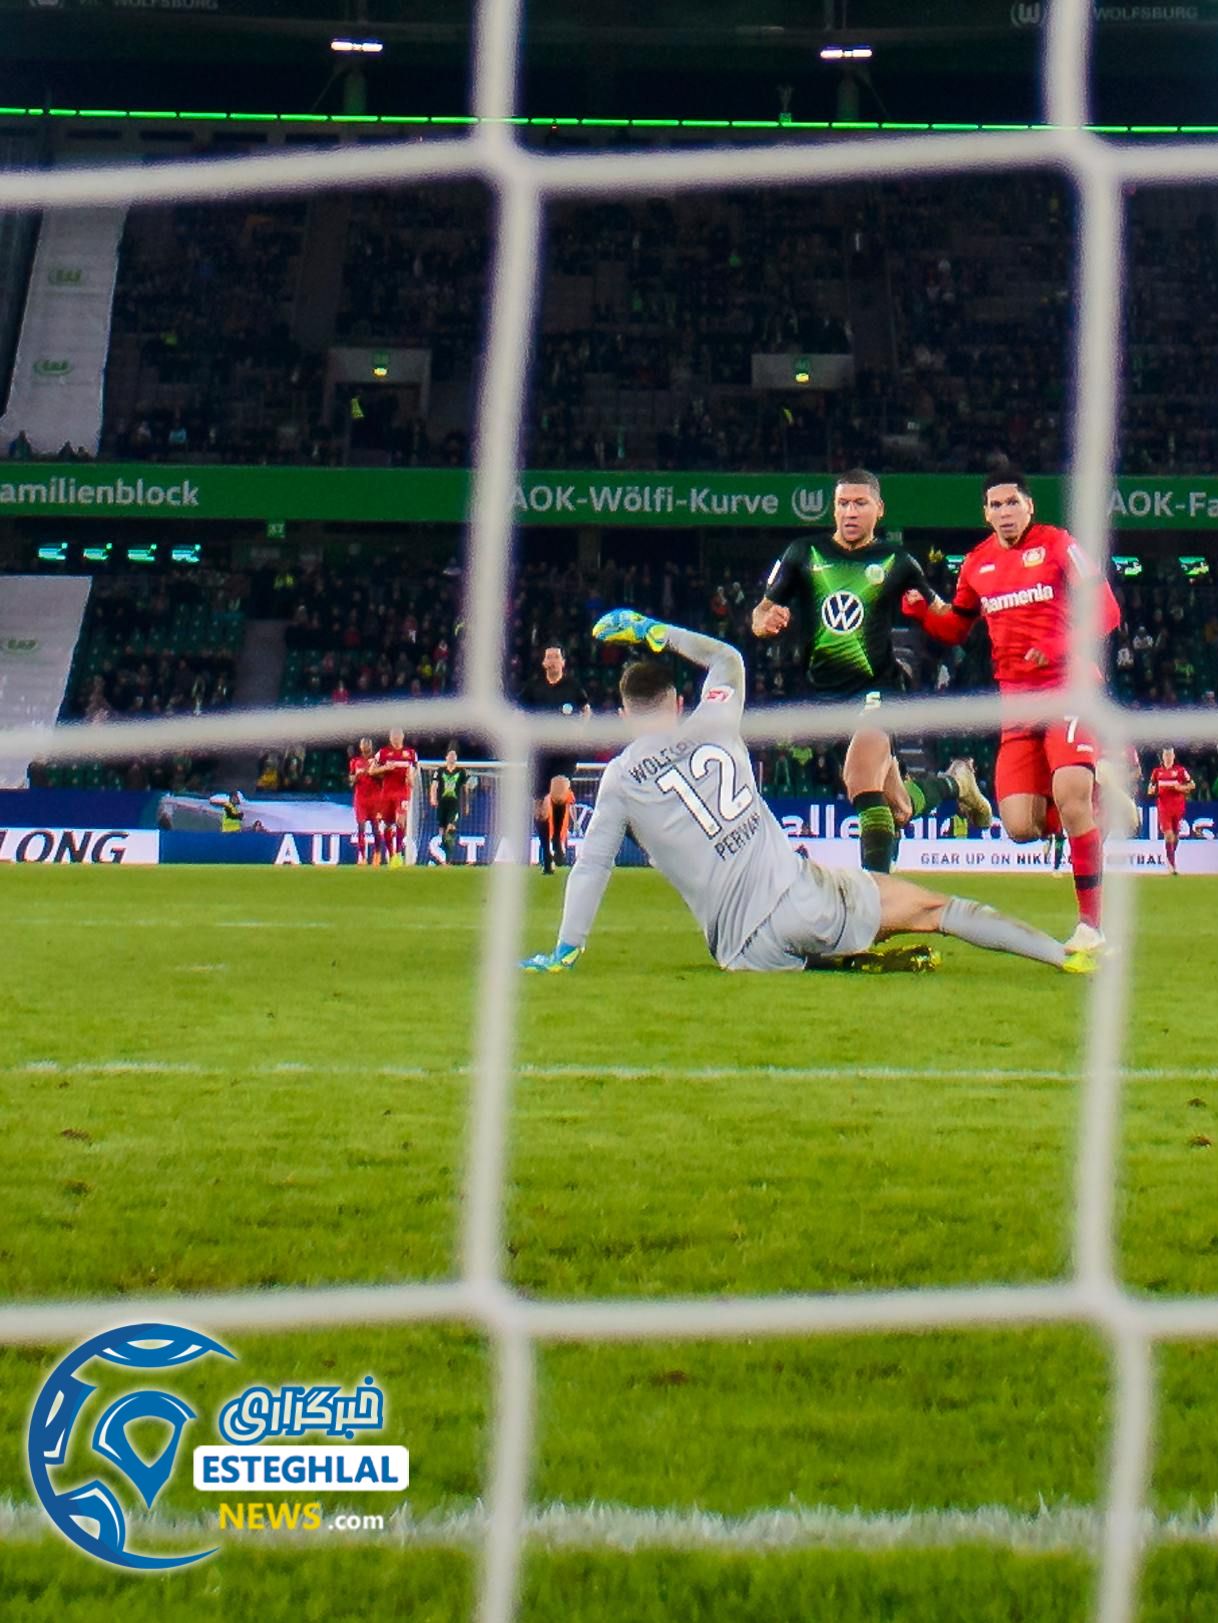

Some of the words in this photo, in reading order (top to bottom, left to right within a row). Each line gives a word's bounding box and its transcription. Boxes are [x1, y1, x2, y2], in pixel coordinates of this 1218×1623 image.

[511, 485, 779, 515] AOK-Wölfi-Kurve
[655, 743, 753, 840] 12
[921, 853, 960, 865] GEAR
[966, 853, 985, 865] UP
[991, 853, 1011, 865] ON
